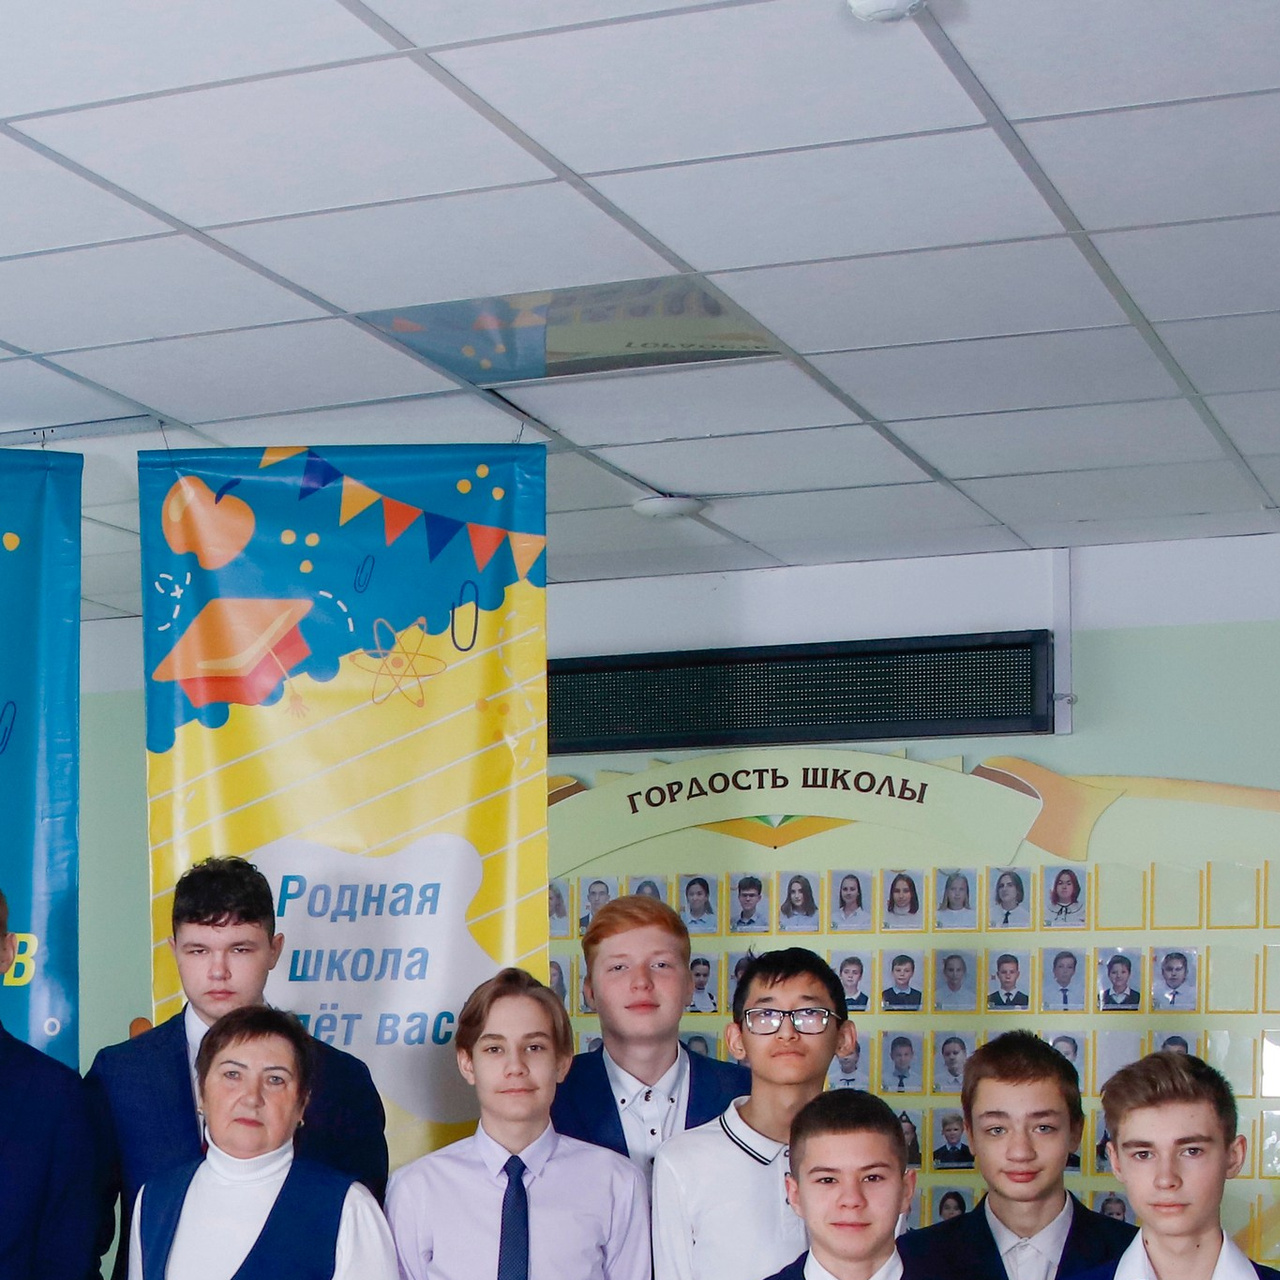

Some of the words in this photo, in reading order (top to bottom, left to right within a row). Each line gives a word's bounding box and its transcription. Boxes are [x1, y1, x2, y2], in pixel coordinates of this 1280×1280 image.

[626, 768, 789, 814] ГОРДОСТЬ
[801, 767, 928, 804] ШКОЛЫ
[276, 874, 442, 923] Родная
[288, 946, 430, 982] школа
[299, 1003, 363, 1046] ёт
[375, 1011, 455, 1046] вас
